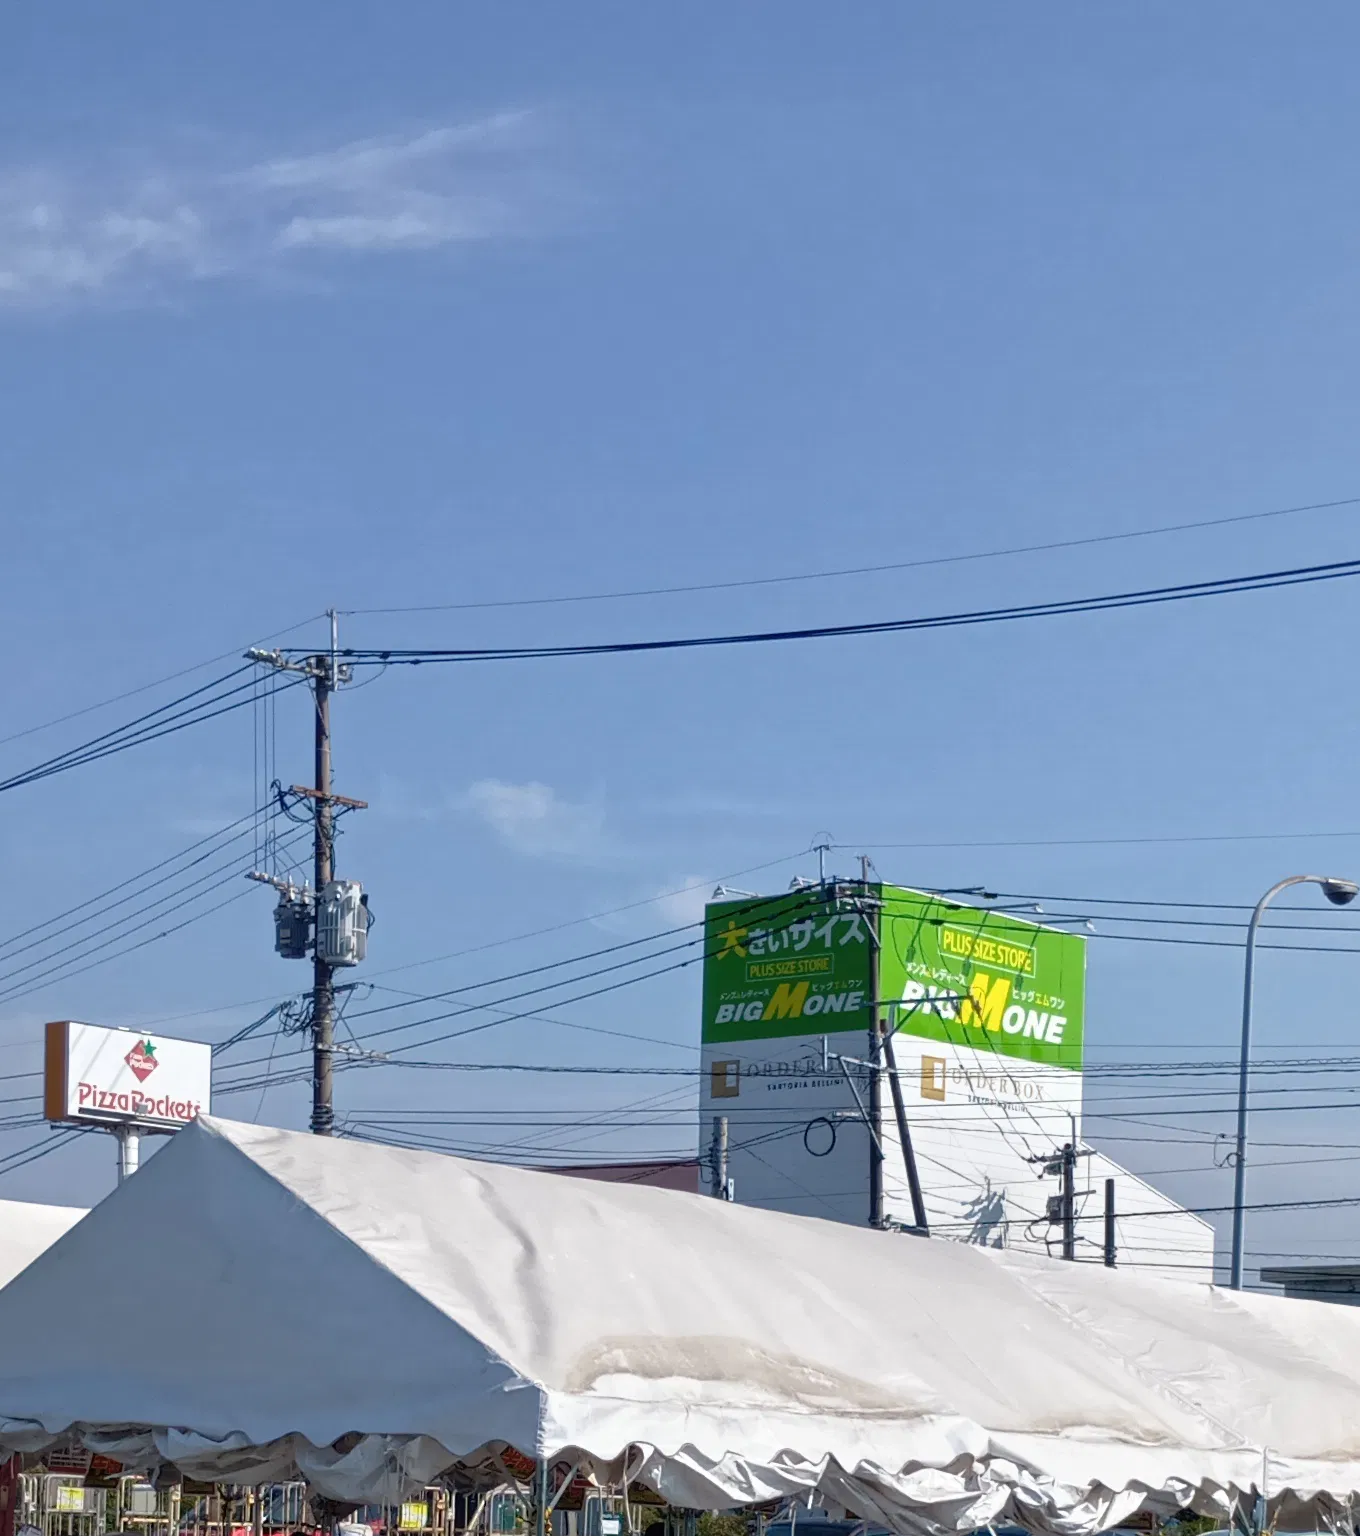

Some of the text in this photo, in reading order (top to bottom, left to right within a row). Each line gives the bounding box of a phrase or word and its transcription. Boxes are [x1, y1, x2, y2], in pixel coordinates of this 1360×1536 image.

[943, 930, 1032, 971] PLUS SIZE STORE
[750, 957, 829, 978] PLUS SIZE STORE
[1014, 1081, 1044, 1101] BOX
